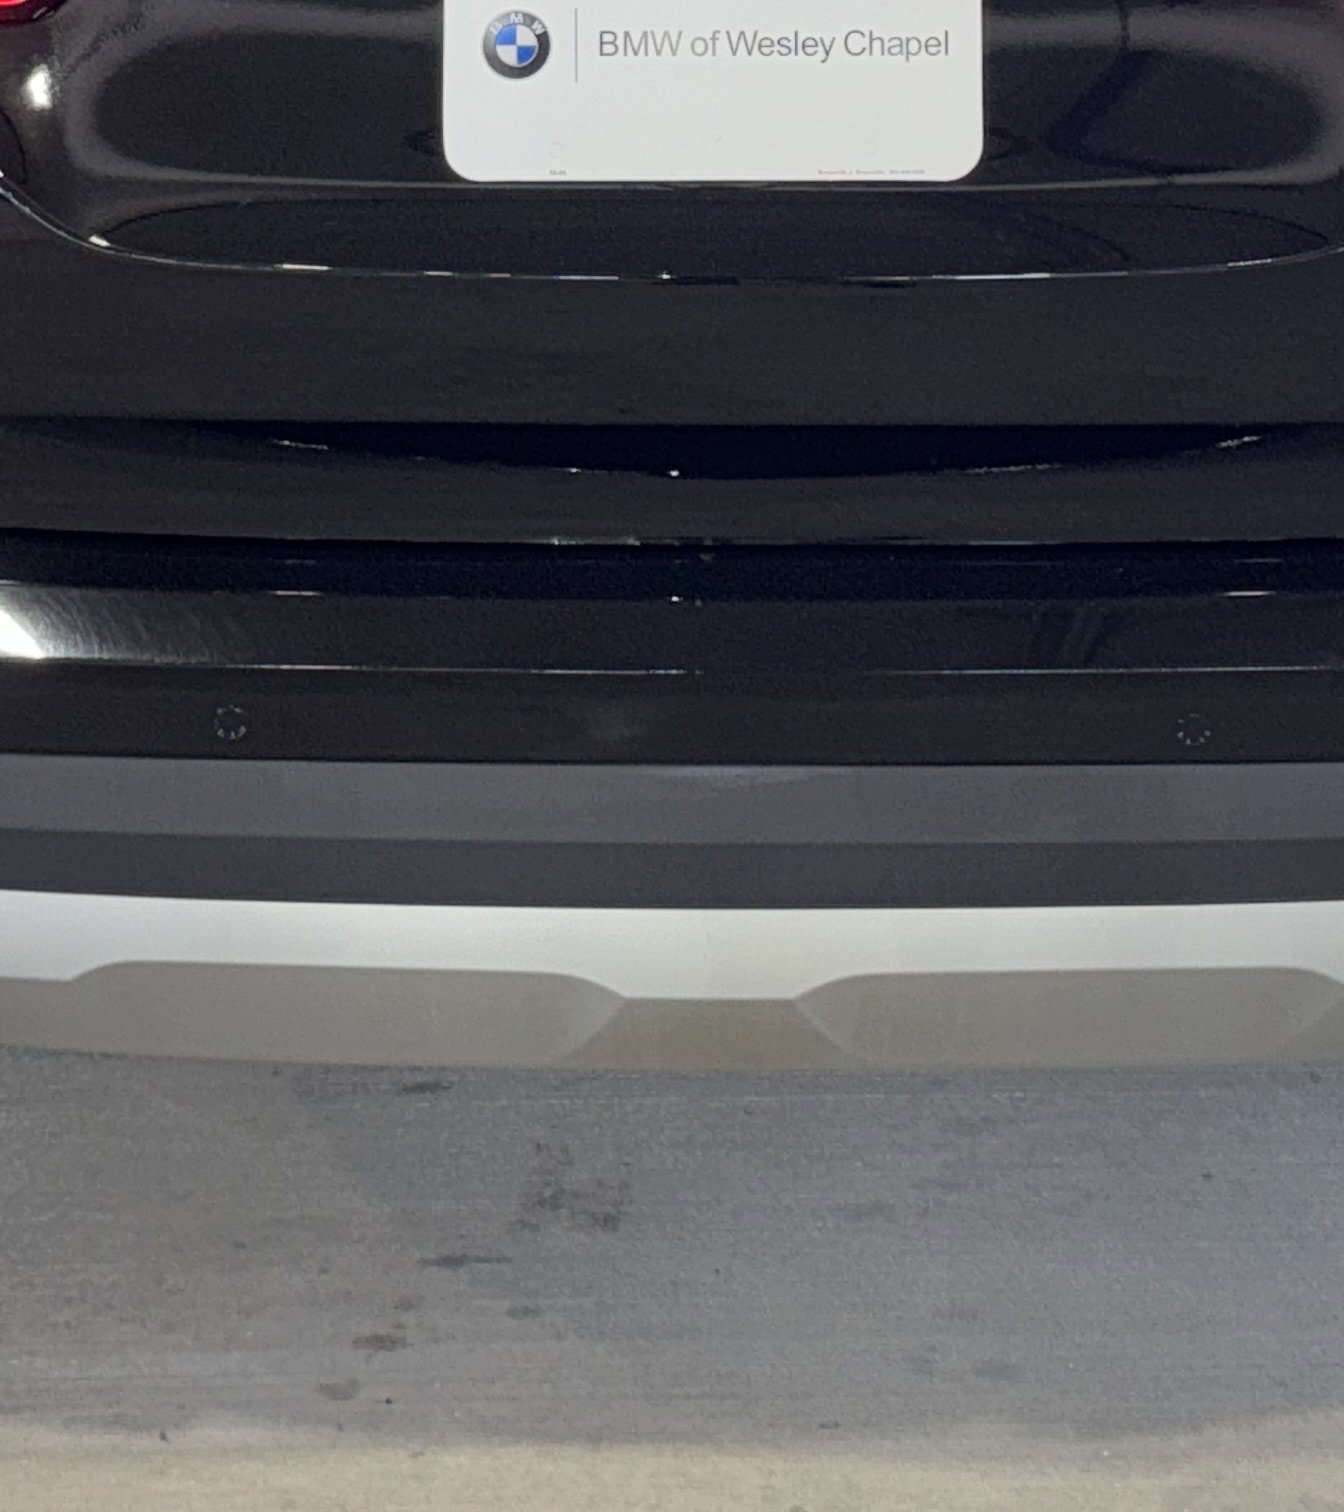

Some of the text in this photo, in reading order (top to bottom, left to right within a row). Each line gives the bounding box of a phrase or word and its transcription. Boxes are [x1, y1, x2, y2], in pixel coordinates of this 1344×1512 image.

[598, 29, 949, 63] BMW of Wesley Chapel
